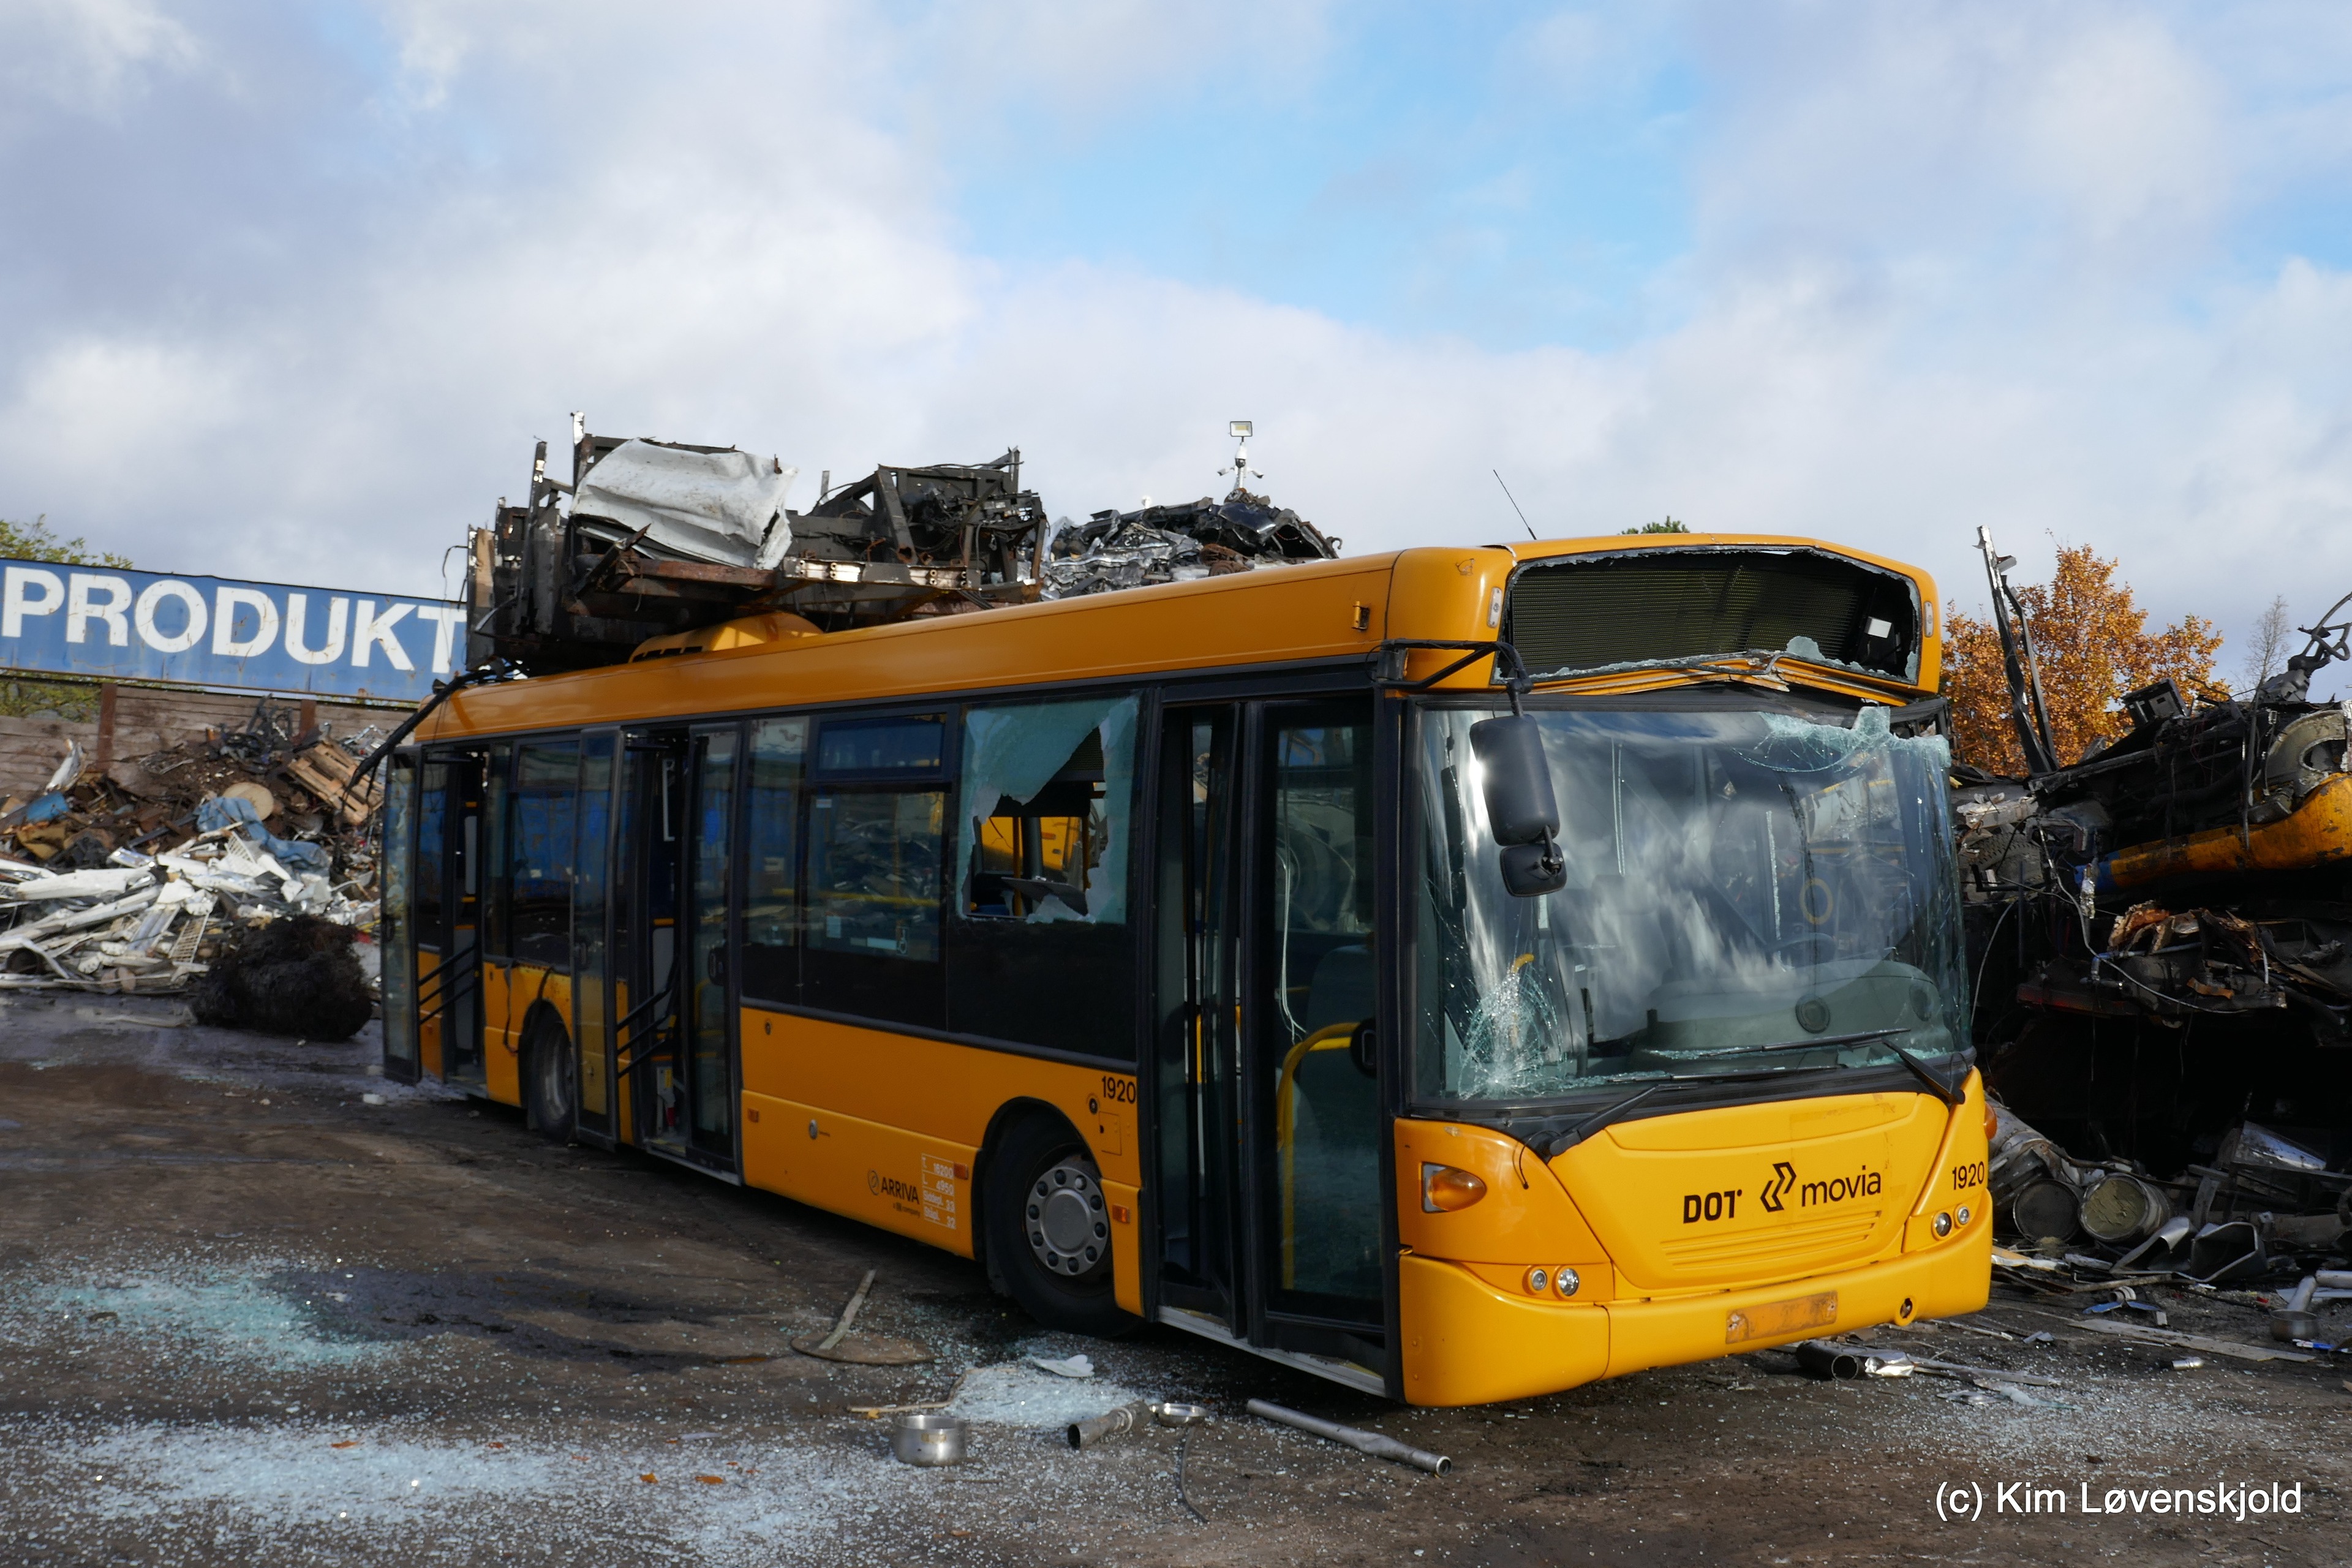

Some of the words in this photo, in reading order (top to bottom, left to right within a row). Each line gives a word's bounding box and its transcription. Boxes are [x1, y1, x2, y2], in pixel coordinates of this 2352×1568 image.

[1, 566, 467, 674] PRODUKT
[1101, 1076, 1136, 1104] 1920
[880, 1176, 920, 1205] ARRIVA
[1801, 1165, 1882, 1207] movia
[1952, 1161, 1985, 1190] 1920
[1683, 1189, 1743, 1224] DOT
